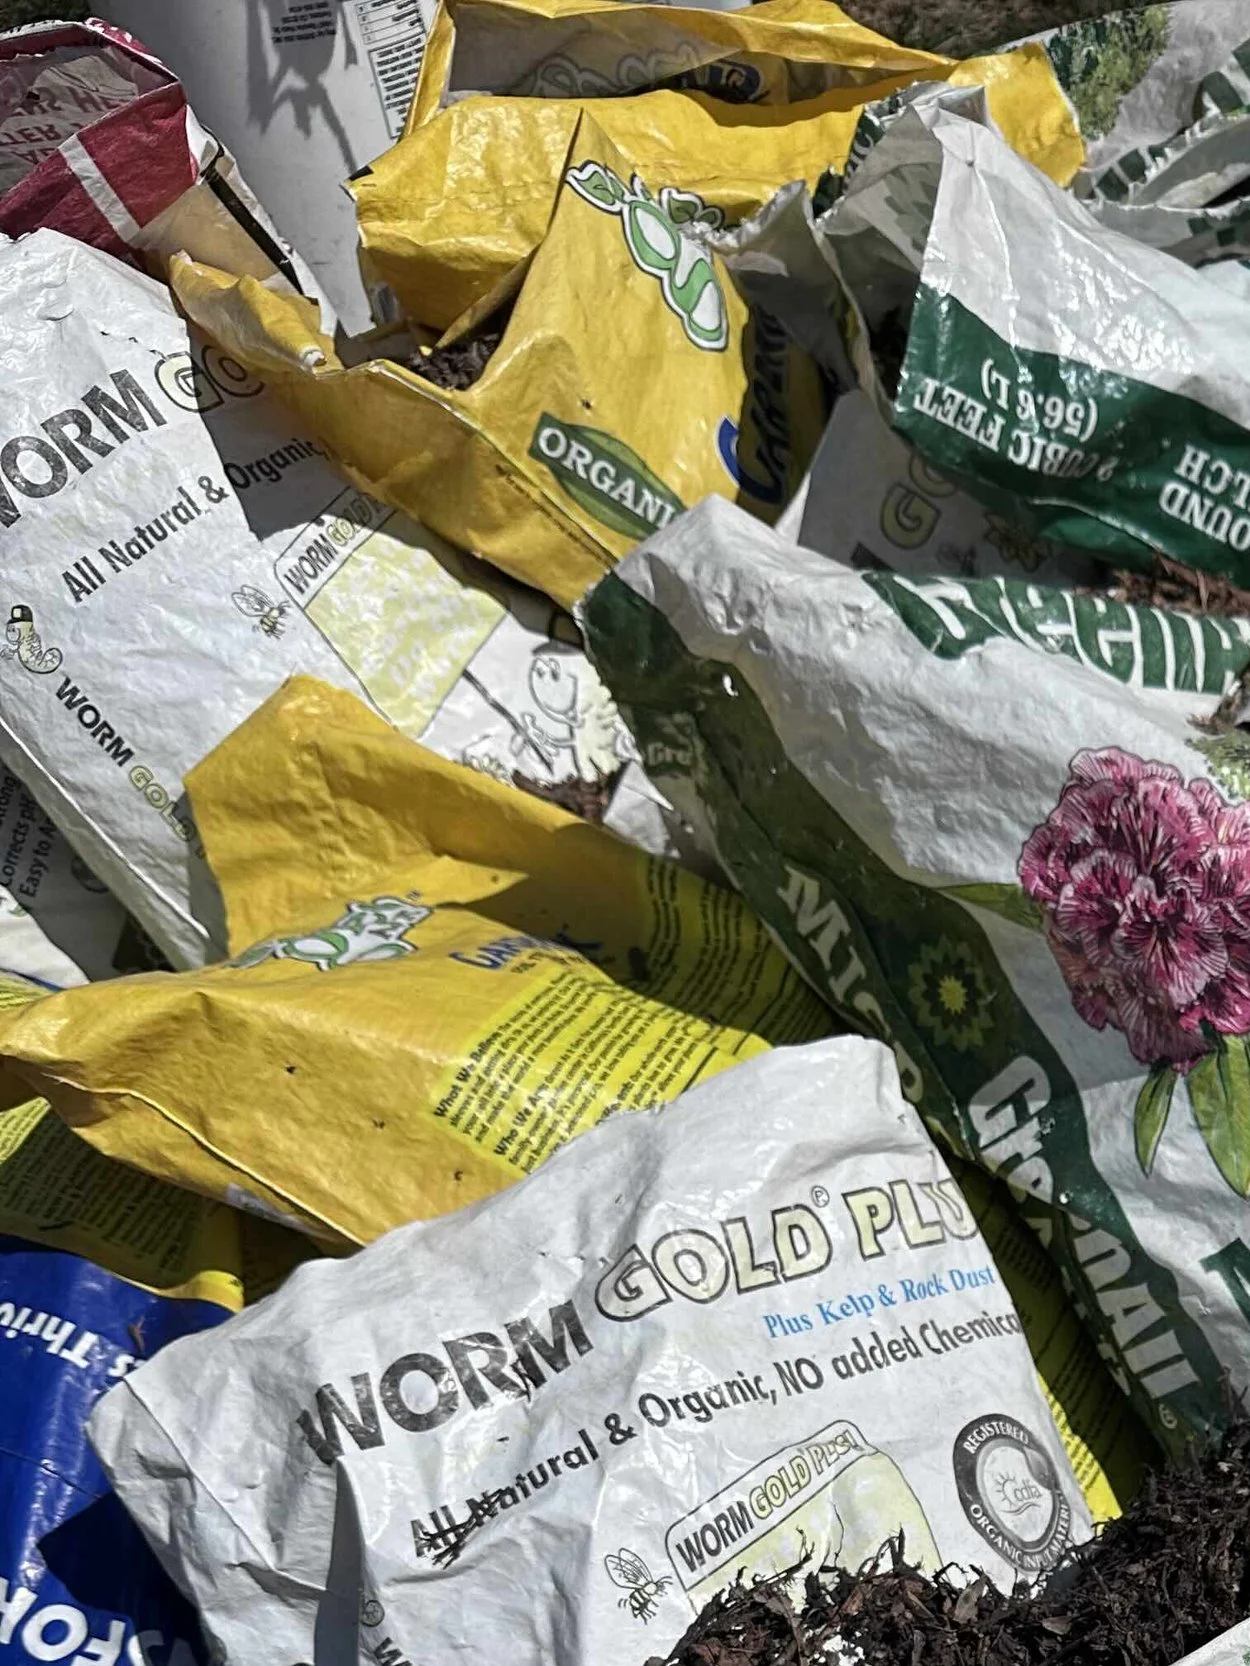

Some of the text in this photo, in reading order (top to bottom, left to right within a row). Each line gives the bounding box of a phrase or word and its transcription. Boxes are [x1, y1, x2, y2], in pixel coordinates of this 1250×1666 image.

[912, 376, 1006, 453] FEET
[538, 427, 678, 531] ORGANI
[1007, 428, 1101, 479] CUBIC
[61, 437, 331, 603] All Natural & Organic,
[282, 534, 338, 595] WORM
[54, 674, 197, 842] WORM GOLD
[20, 853, 49, 897] Easy
[433, 1082, 463, 1118] What
[455, 1061, 476, 1083] We
[493, 1125, 519, 1155] Who
[762, 1266, 997, 1340] Plus Kelp & Rock Dust
[297, 1299, 594, 1466] WORM
[603, 1412, 638, 1447] &
[638, 1368, 780, 1429] Organic,
[772, 1357, 826, 1399] NO
[831, 1325, 923, 1382] added
[963, 1420, 1030, 1455] REGISTERED
[675, 1500, 755, 1573] WORM
[749, 1454, 813, 1520] GOLD
[969, 1503, 1025, 1566] ORGANIC
